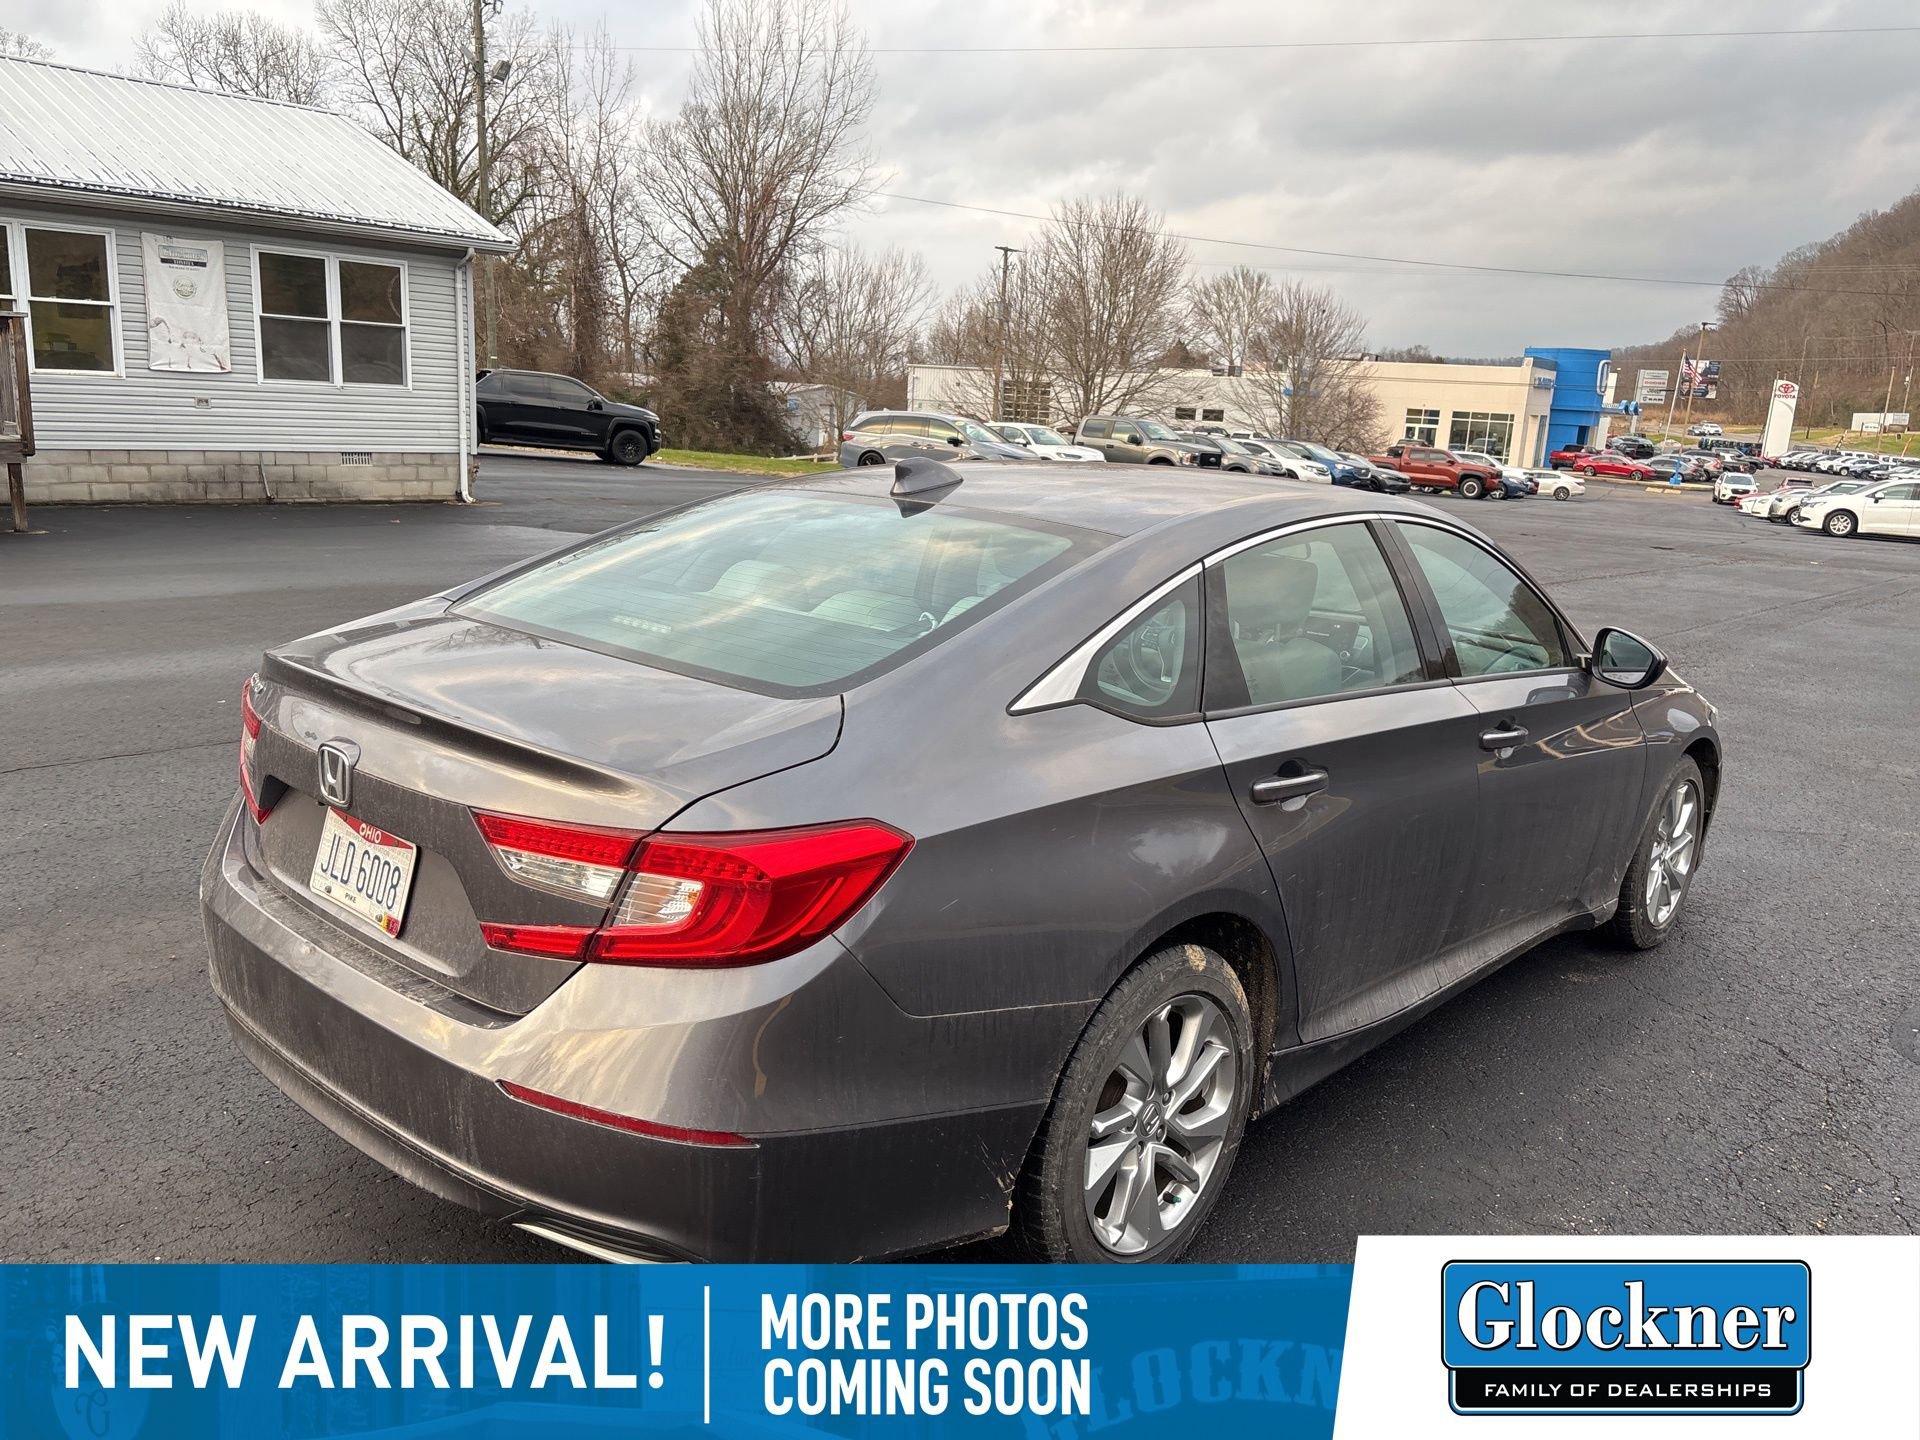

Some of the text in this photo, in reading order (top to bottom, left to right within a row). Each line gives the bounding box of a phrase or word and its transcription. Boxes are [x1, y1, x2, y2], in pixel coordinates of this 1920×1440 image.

[359, 823, 382, 843] OHIO
[320, 833, 402, 910] JLD 6008
